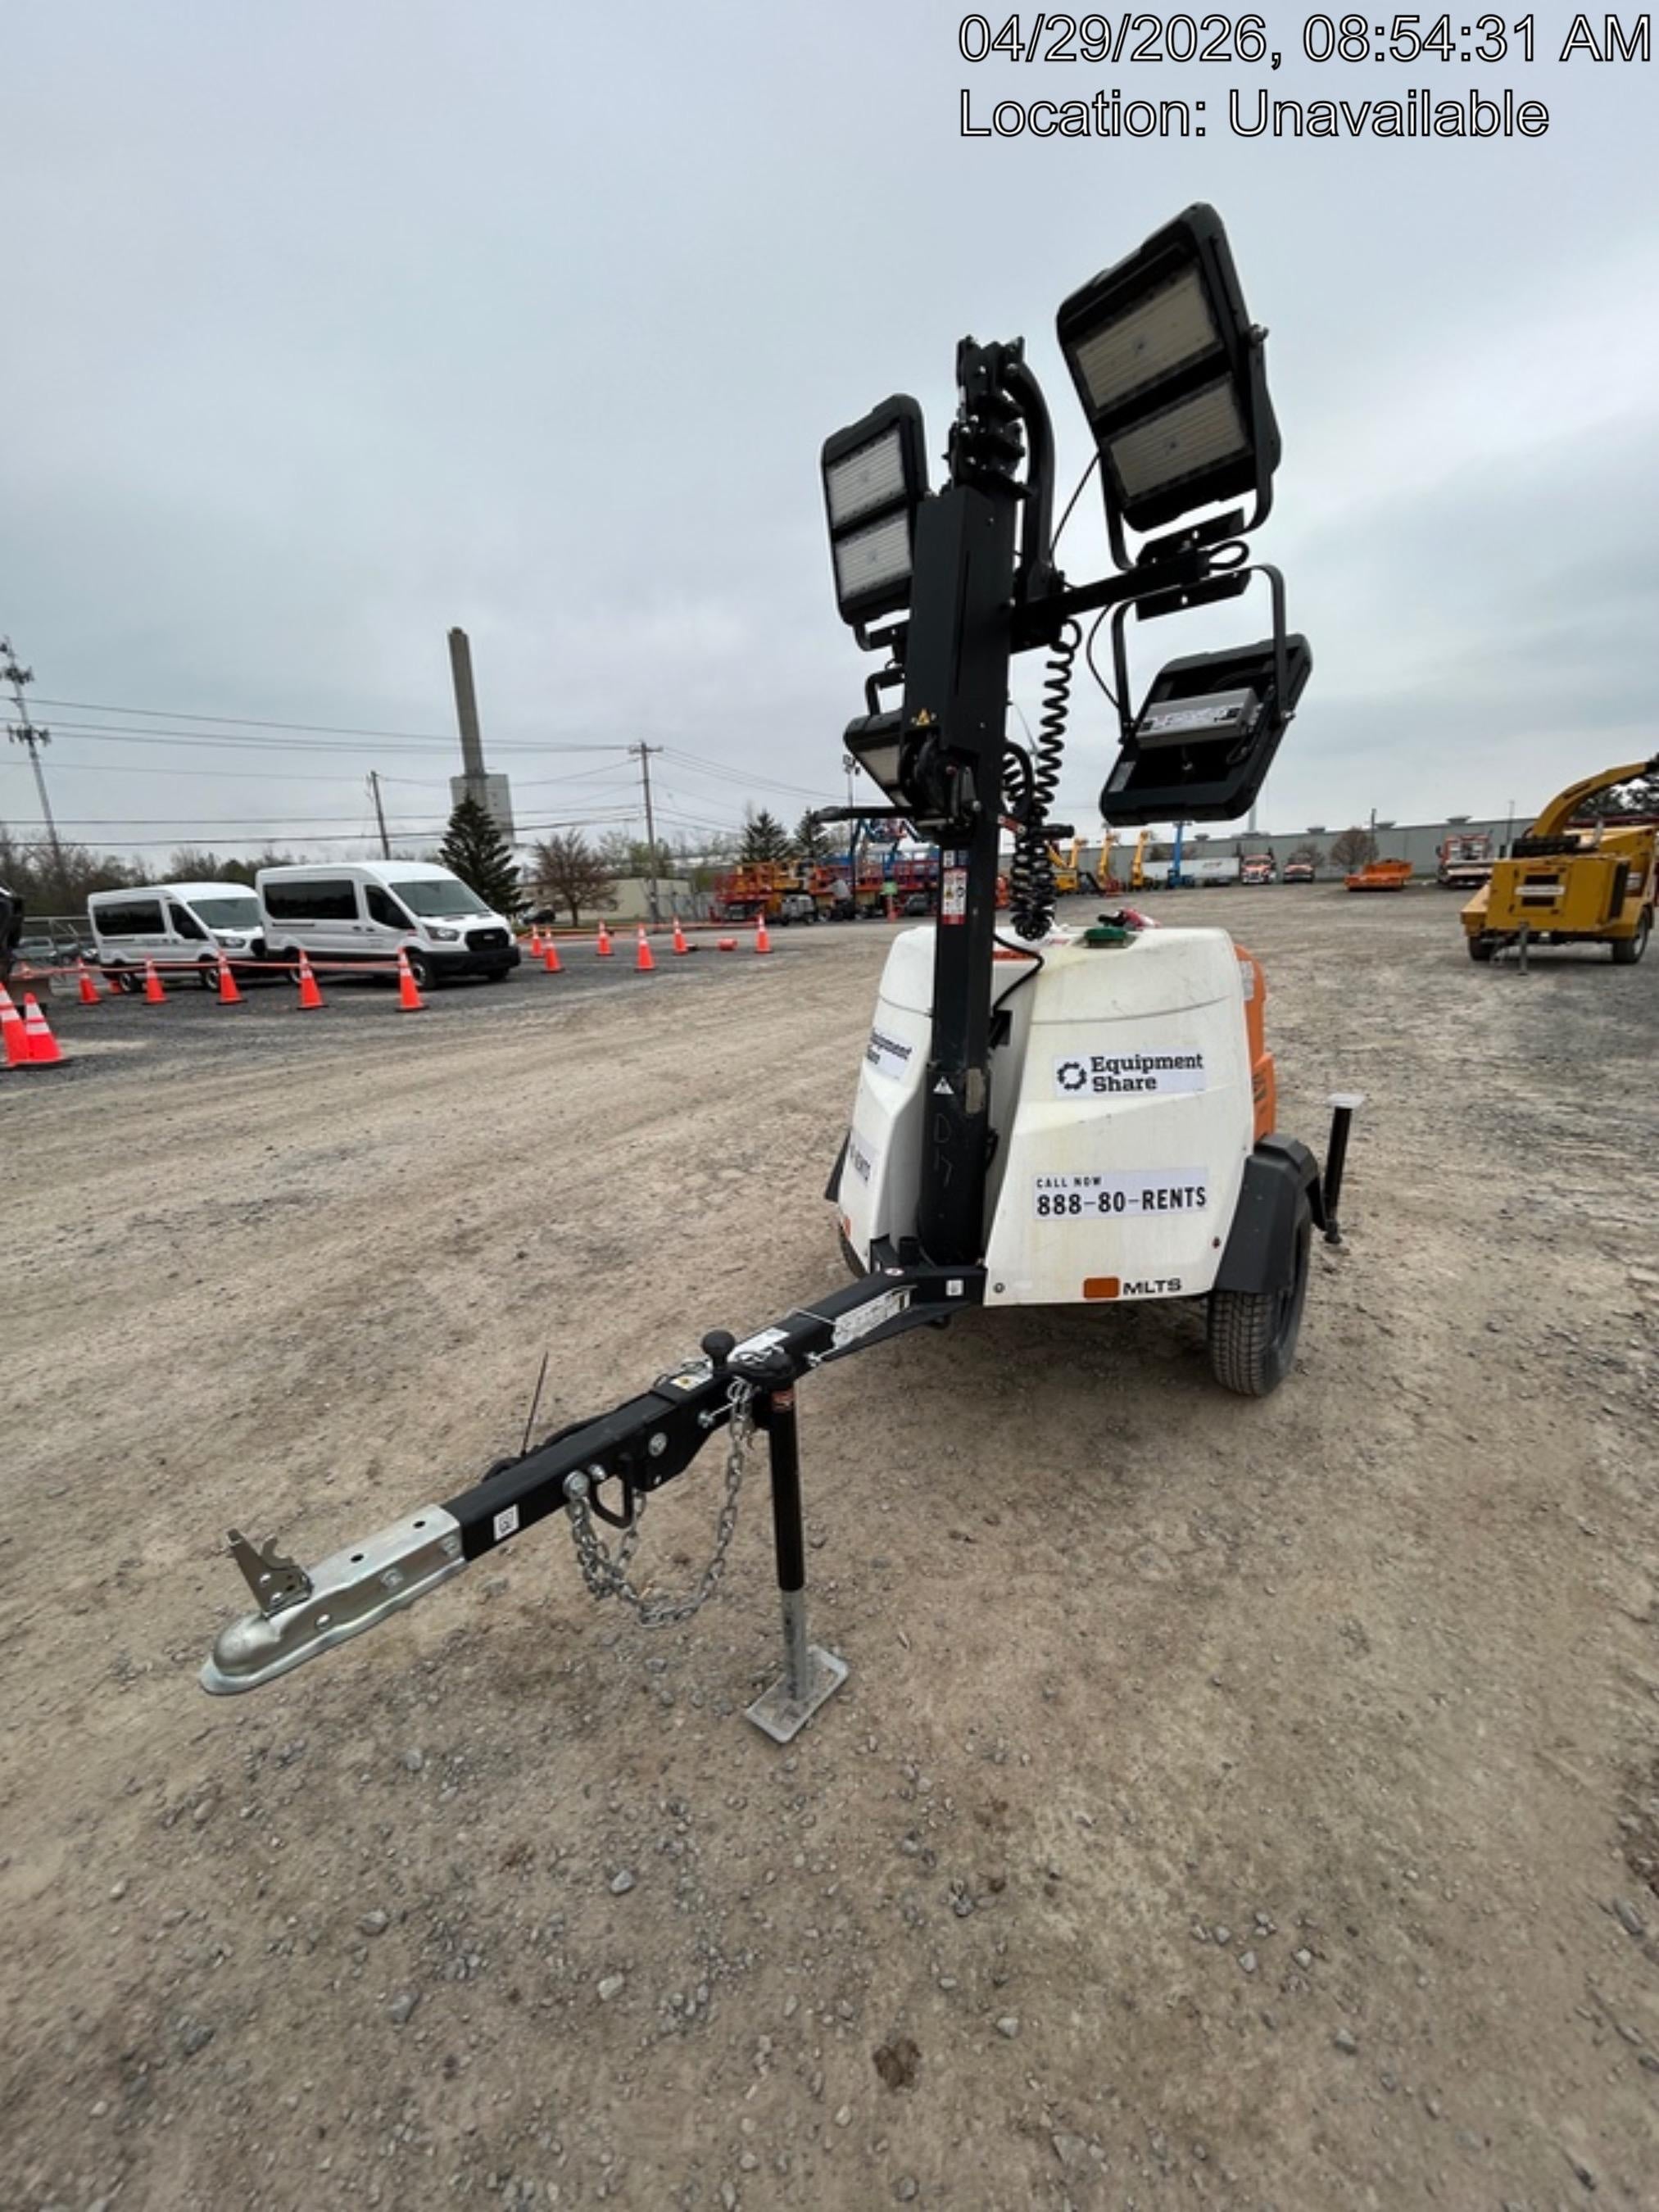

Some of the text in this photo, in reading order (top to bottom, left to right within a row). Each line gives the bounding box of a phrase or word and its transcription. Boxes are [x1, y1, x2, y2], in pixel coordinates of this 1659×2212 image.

[1090, 1053, 1204, 1075] Equipment
[1092, 1076, 1158, 1093] Share
[1036, 1176, 1102, 1189] CALL NOW
[1036, 1186, 1207, 1217] 888-80-RENTS
[1122, 1277, 1182, 1296] MLTS
